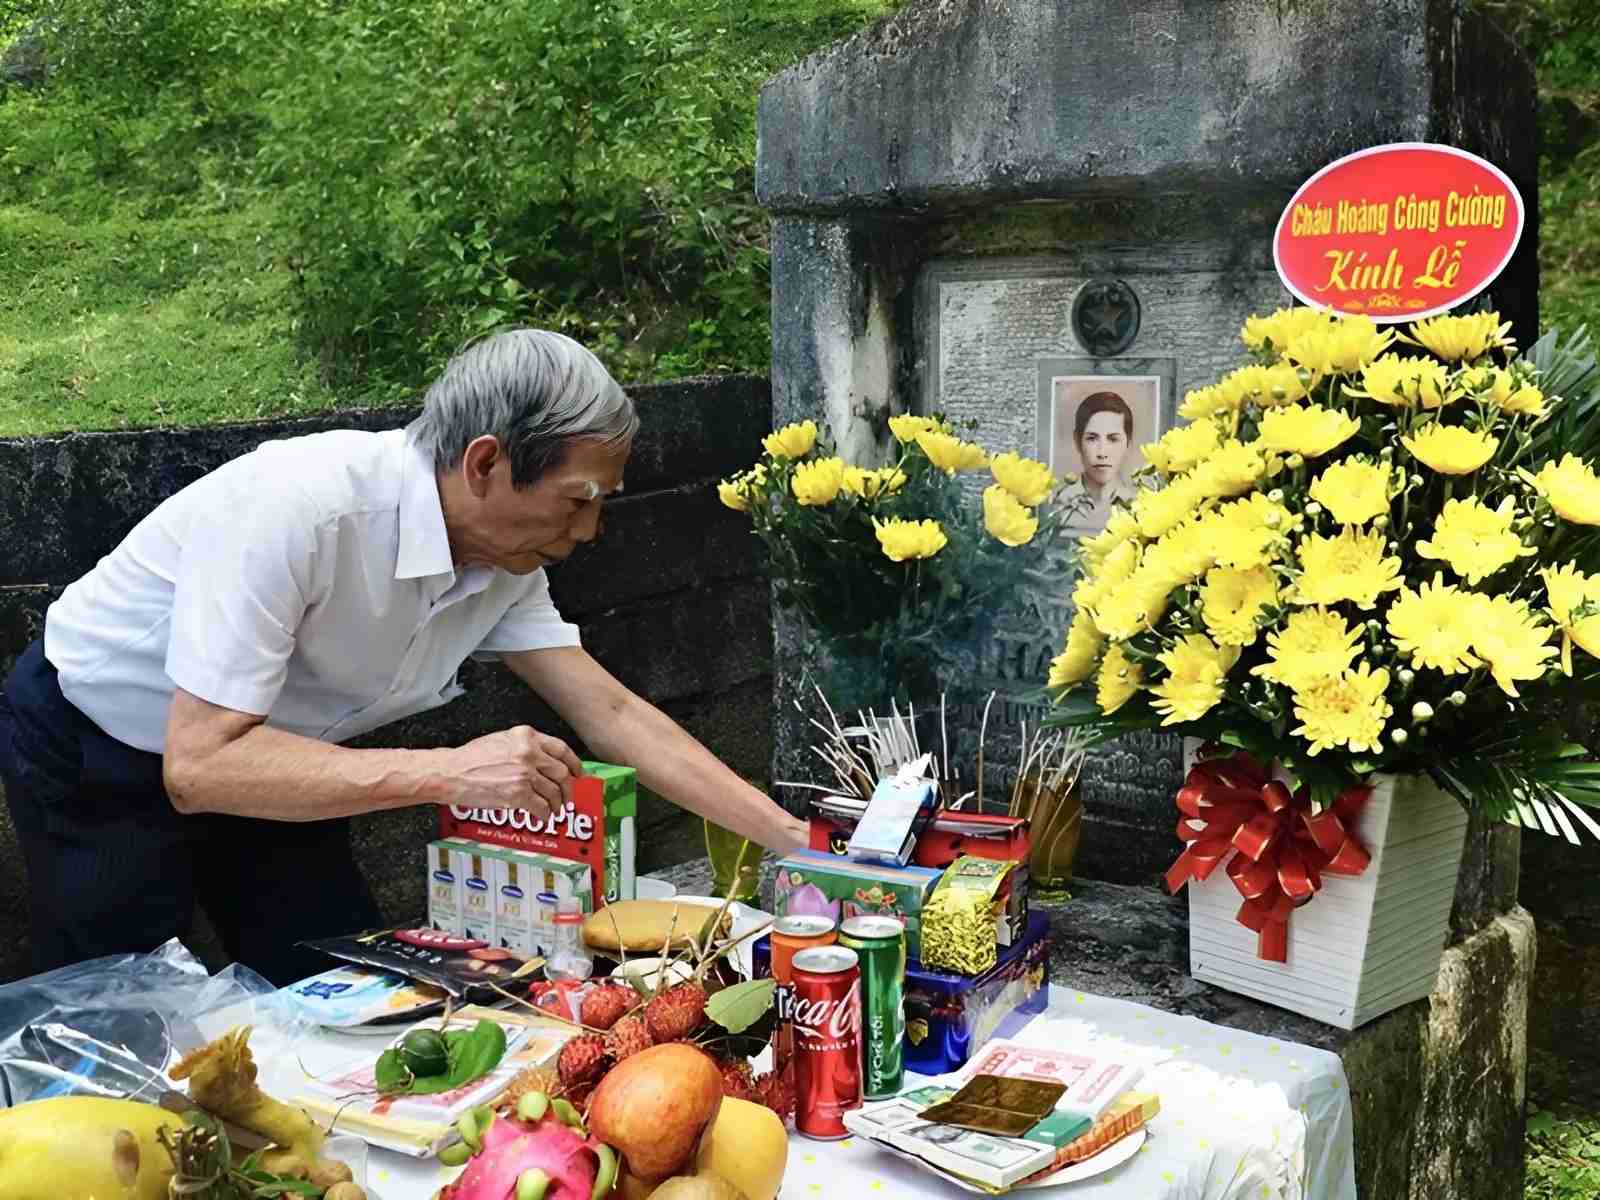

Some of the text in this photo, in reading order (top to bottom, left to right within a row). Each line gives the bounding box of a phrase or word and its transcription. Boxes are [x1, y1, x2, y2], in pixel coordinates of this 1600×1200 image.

[1291, 203, 1332, 237] Cháu
[1393, 193, 1440, 233] Công
[1445, 185, 1506, 229] Cường
[1314, 240, 1468, 292] Kính Lễ
